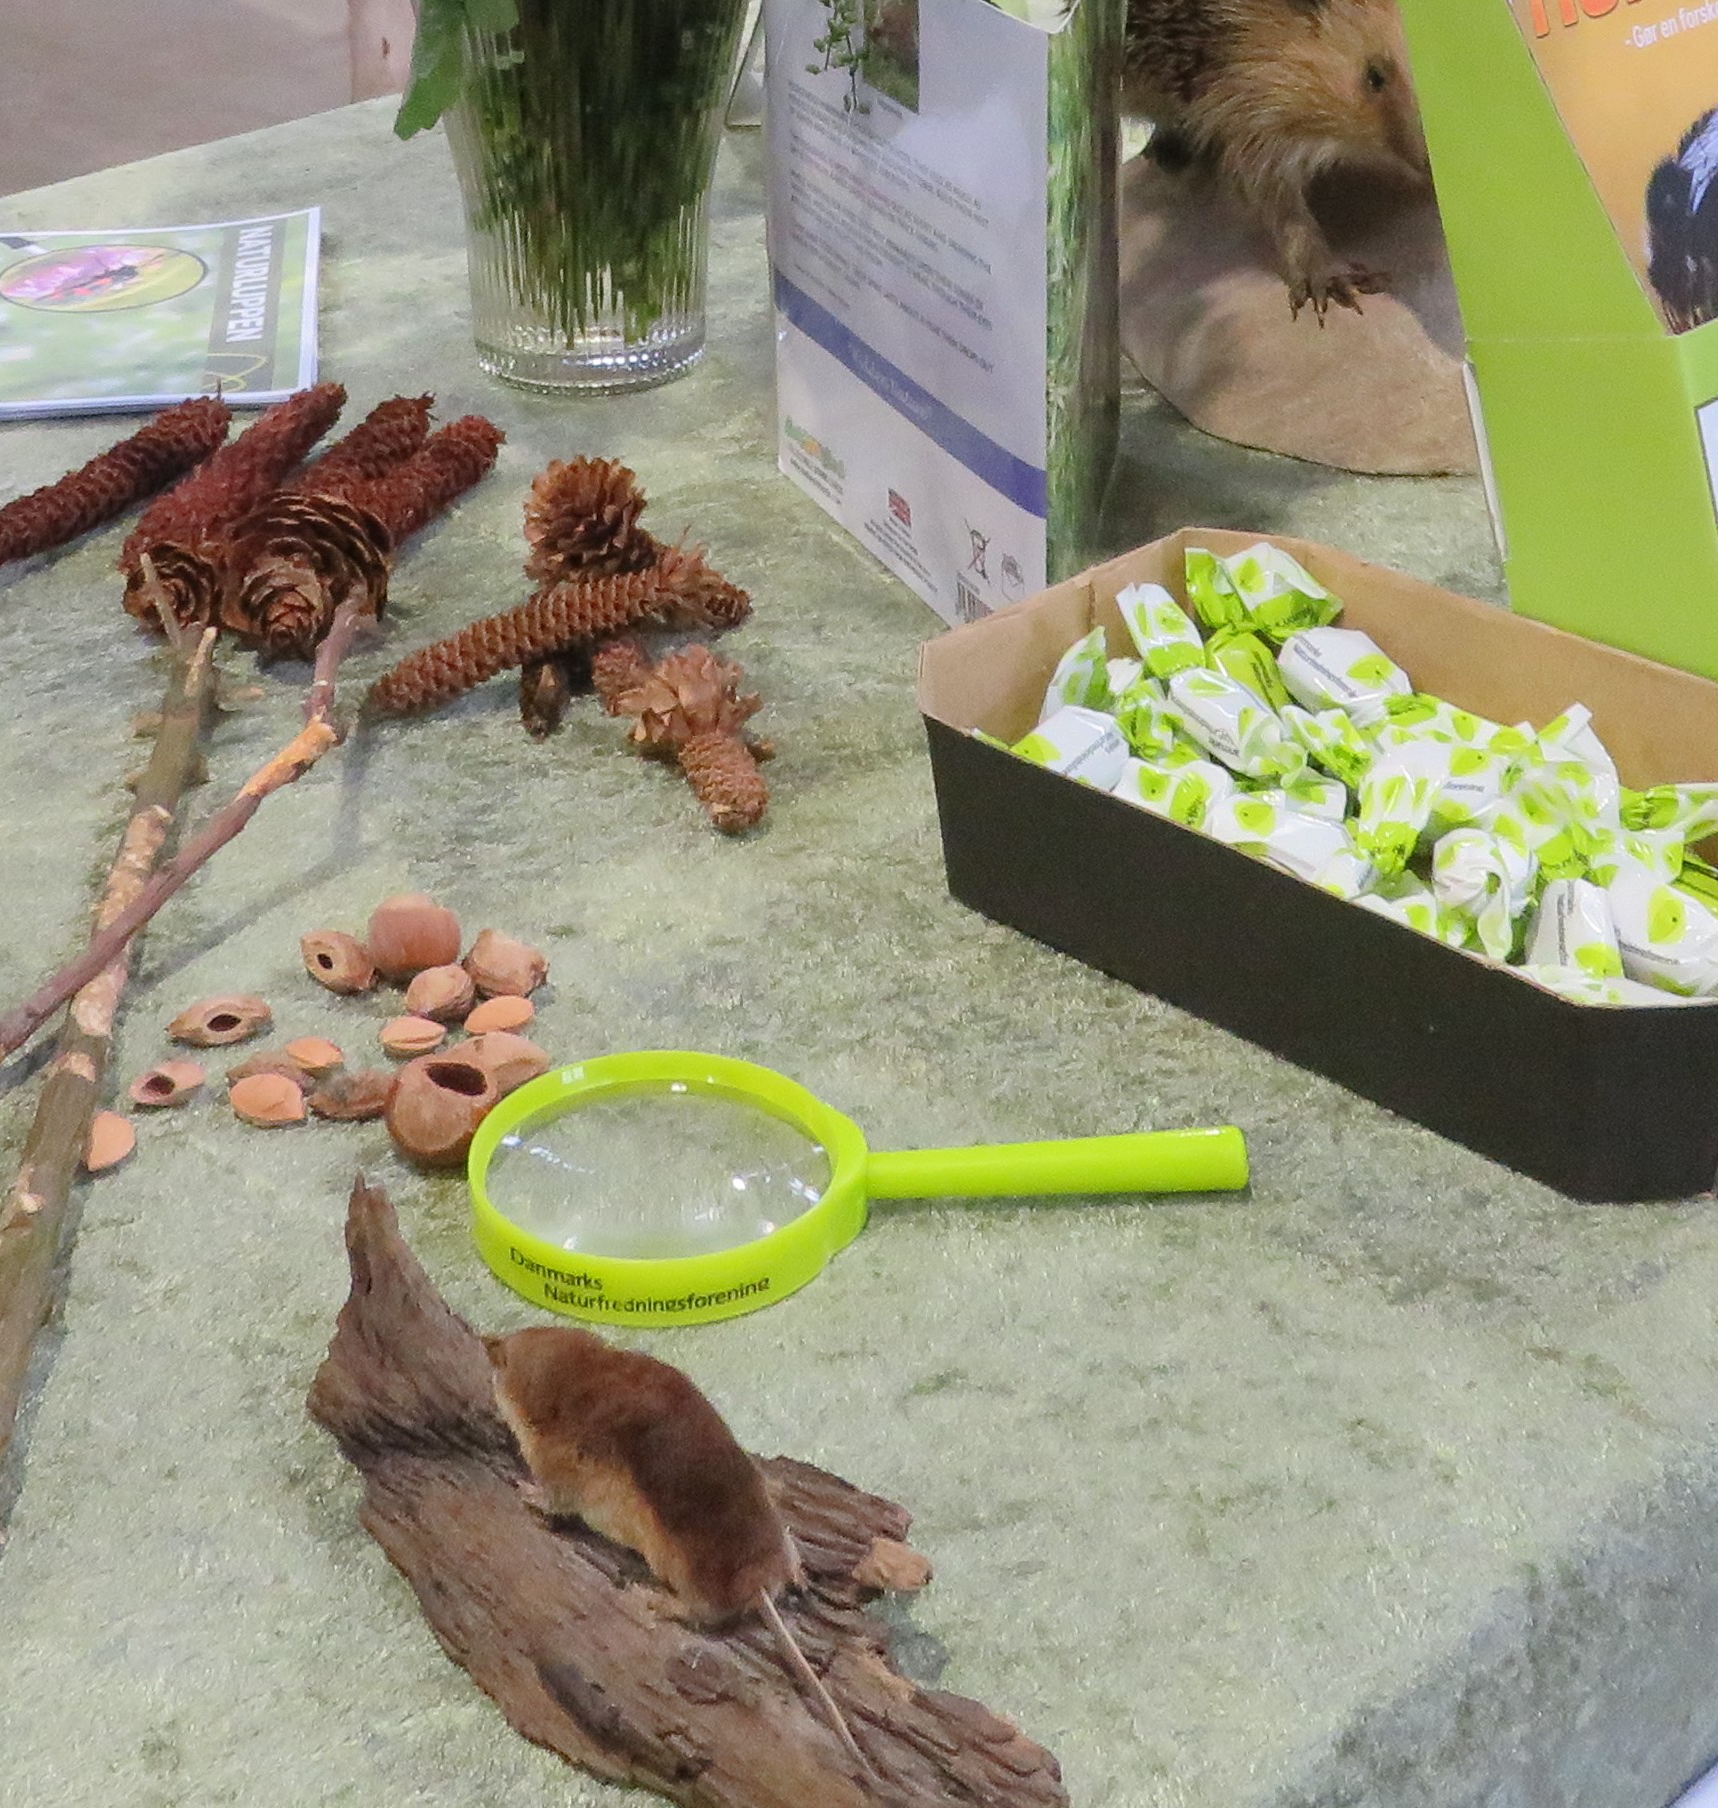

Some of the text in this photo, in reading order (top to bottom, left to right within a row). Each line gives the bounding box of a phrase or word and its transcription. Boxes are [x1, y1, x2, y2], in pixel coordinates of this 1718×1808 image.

[1632, 24, 1659, 49] Gør
[1660, 18, 1679, 39] en
[225, 224, 273, 343] NATURLUPPEN
[509, 1246, 604, 1291] Danmarks
[544, 1275, 771, 1314] Naturfredningsforening
